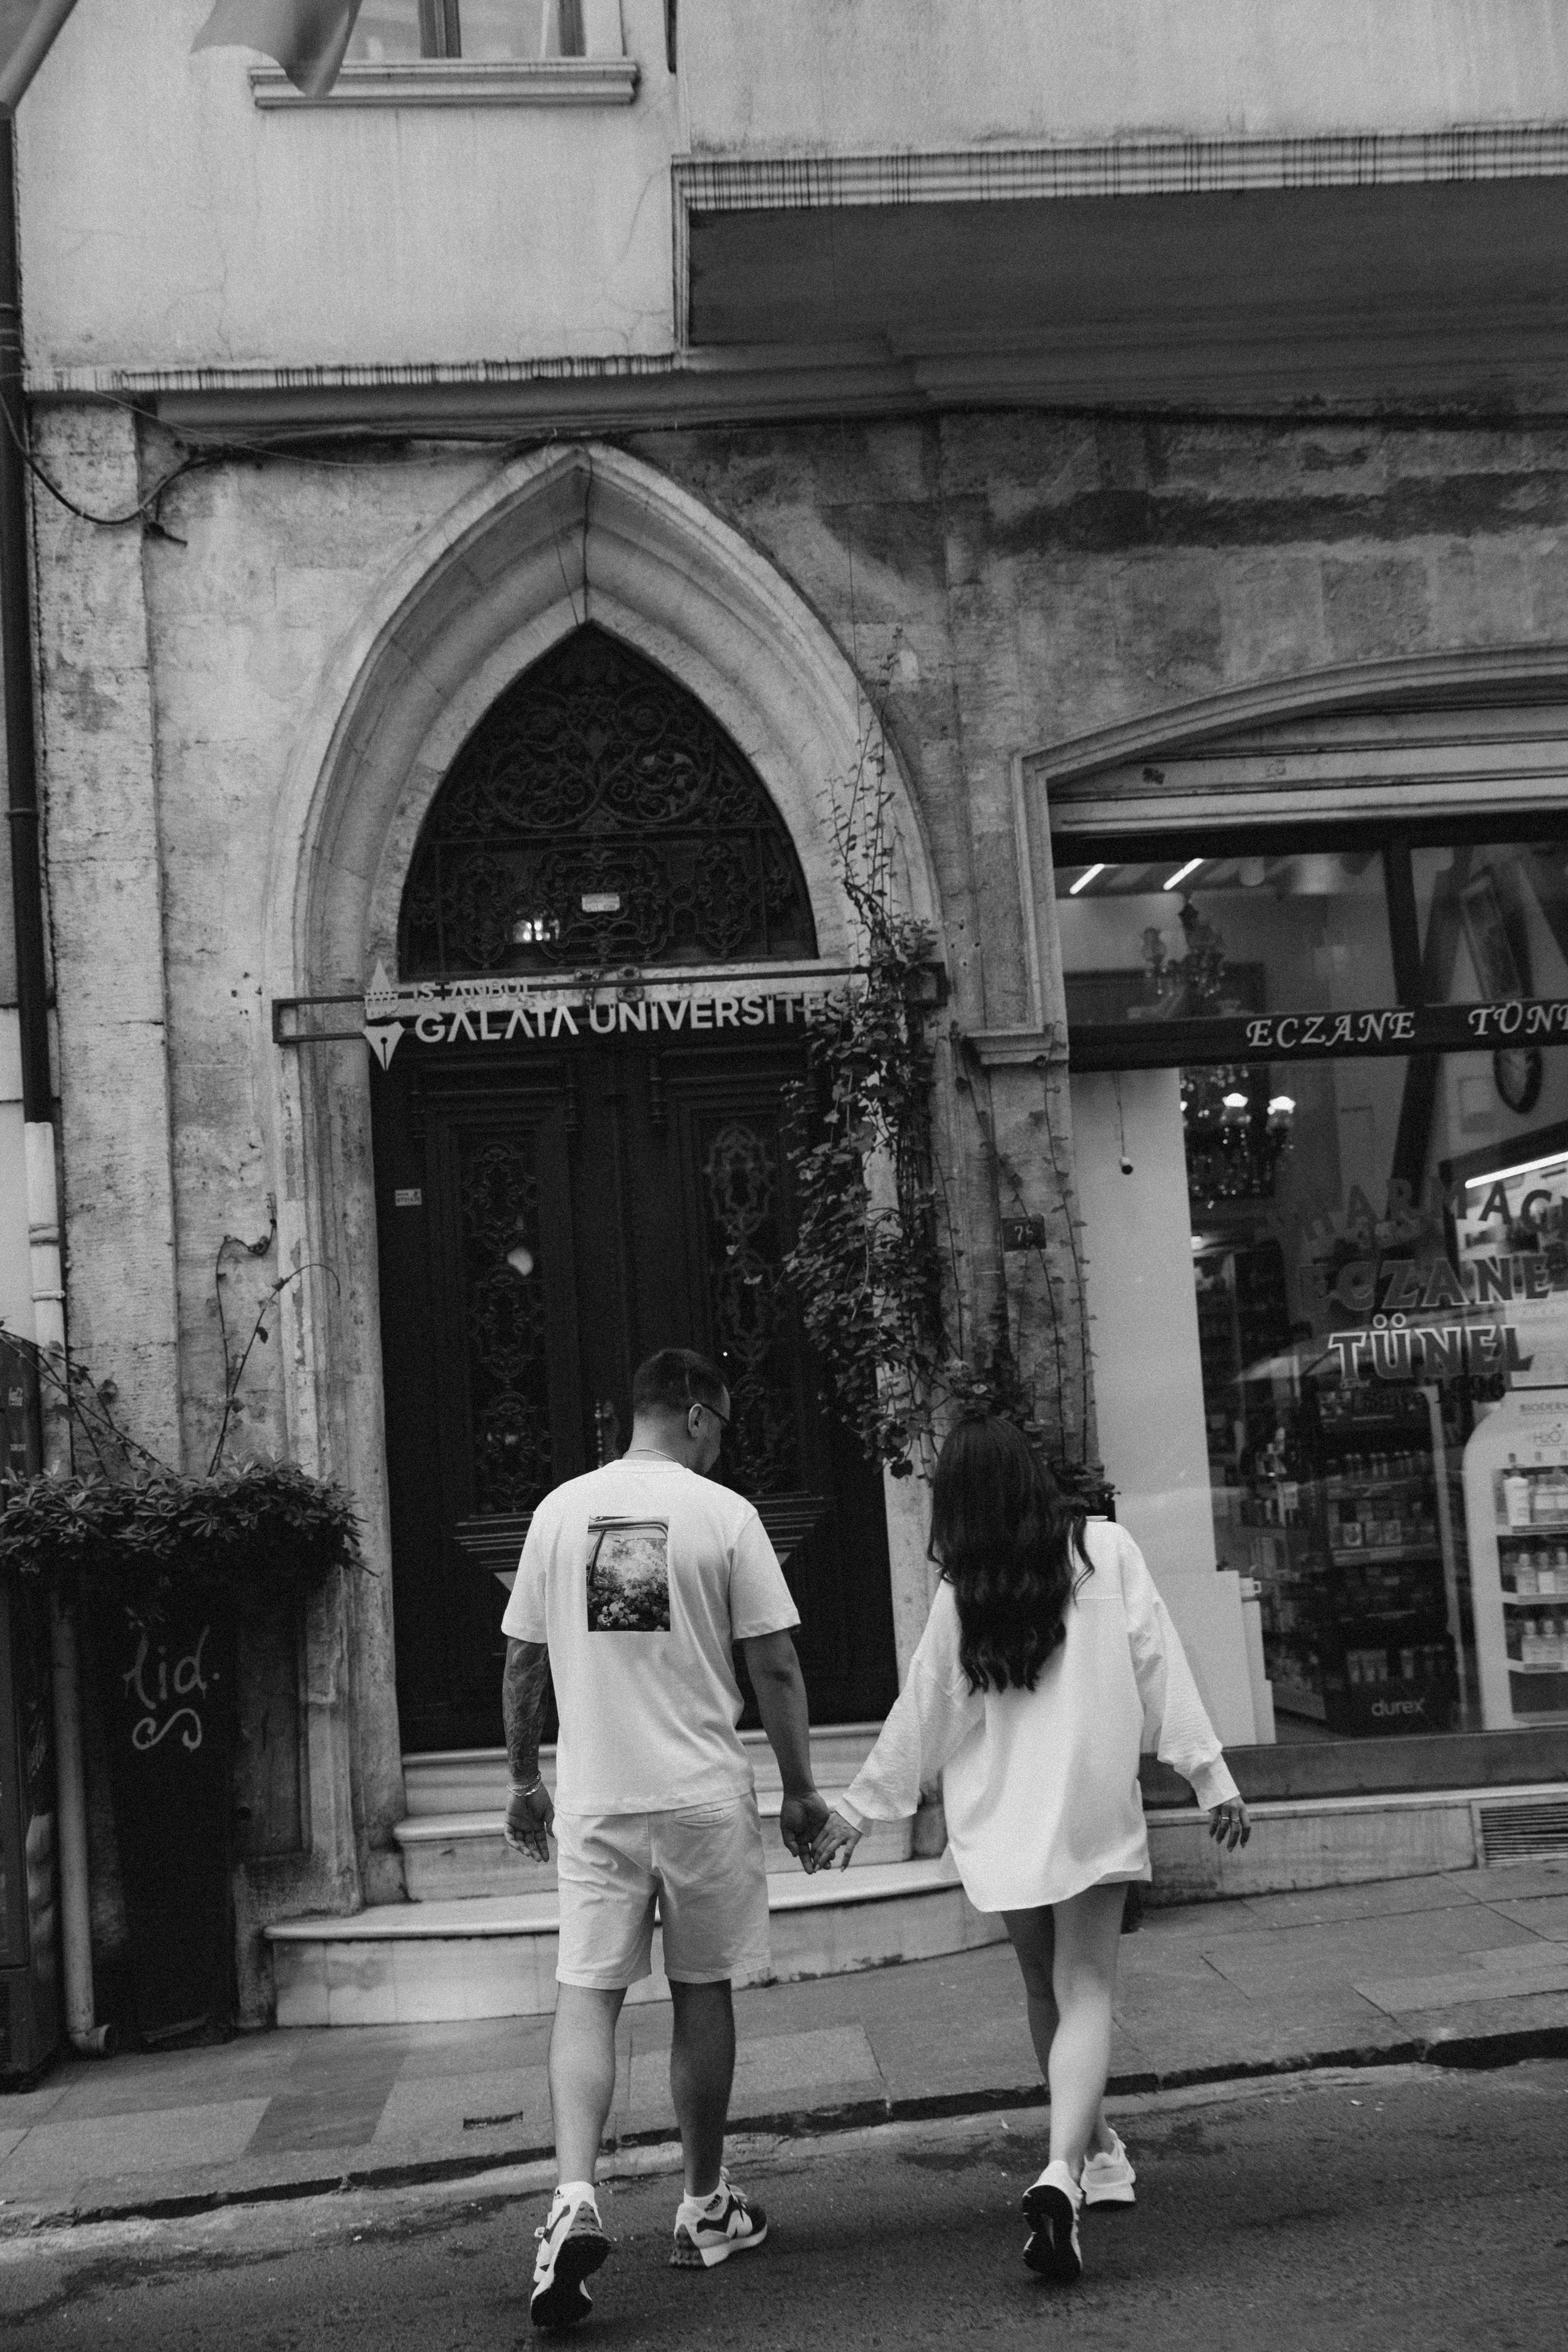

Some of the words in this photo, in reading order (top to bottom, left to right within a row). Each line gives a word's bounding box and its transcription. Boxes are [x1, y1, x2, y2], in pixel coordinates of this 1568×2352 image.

[415, 1004, 581, 1043] GALATA
[1246, 1011, 1415, 1048] ECZANE
[1327, 1312, 1534, 1382] TÜNEL
[1371, 1697, 1426, 1717] durex
